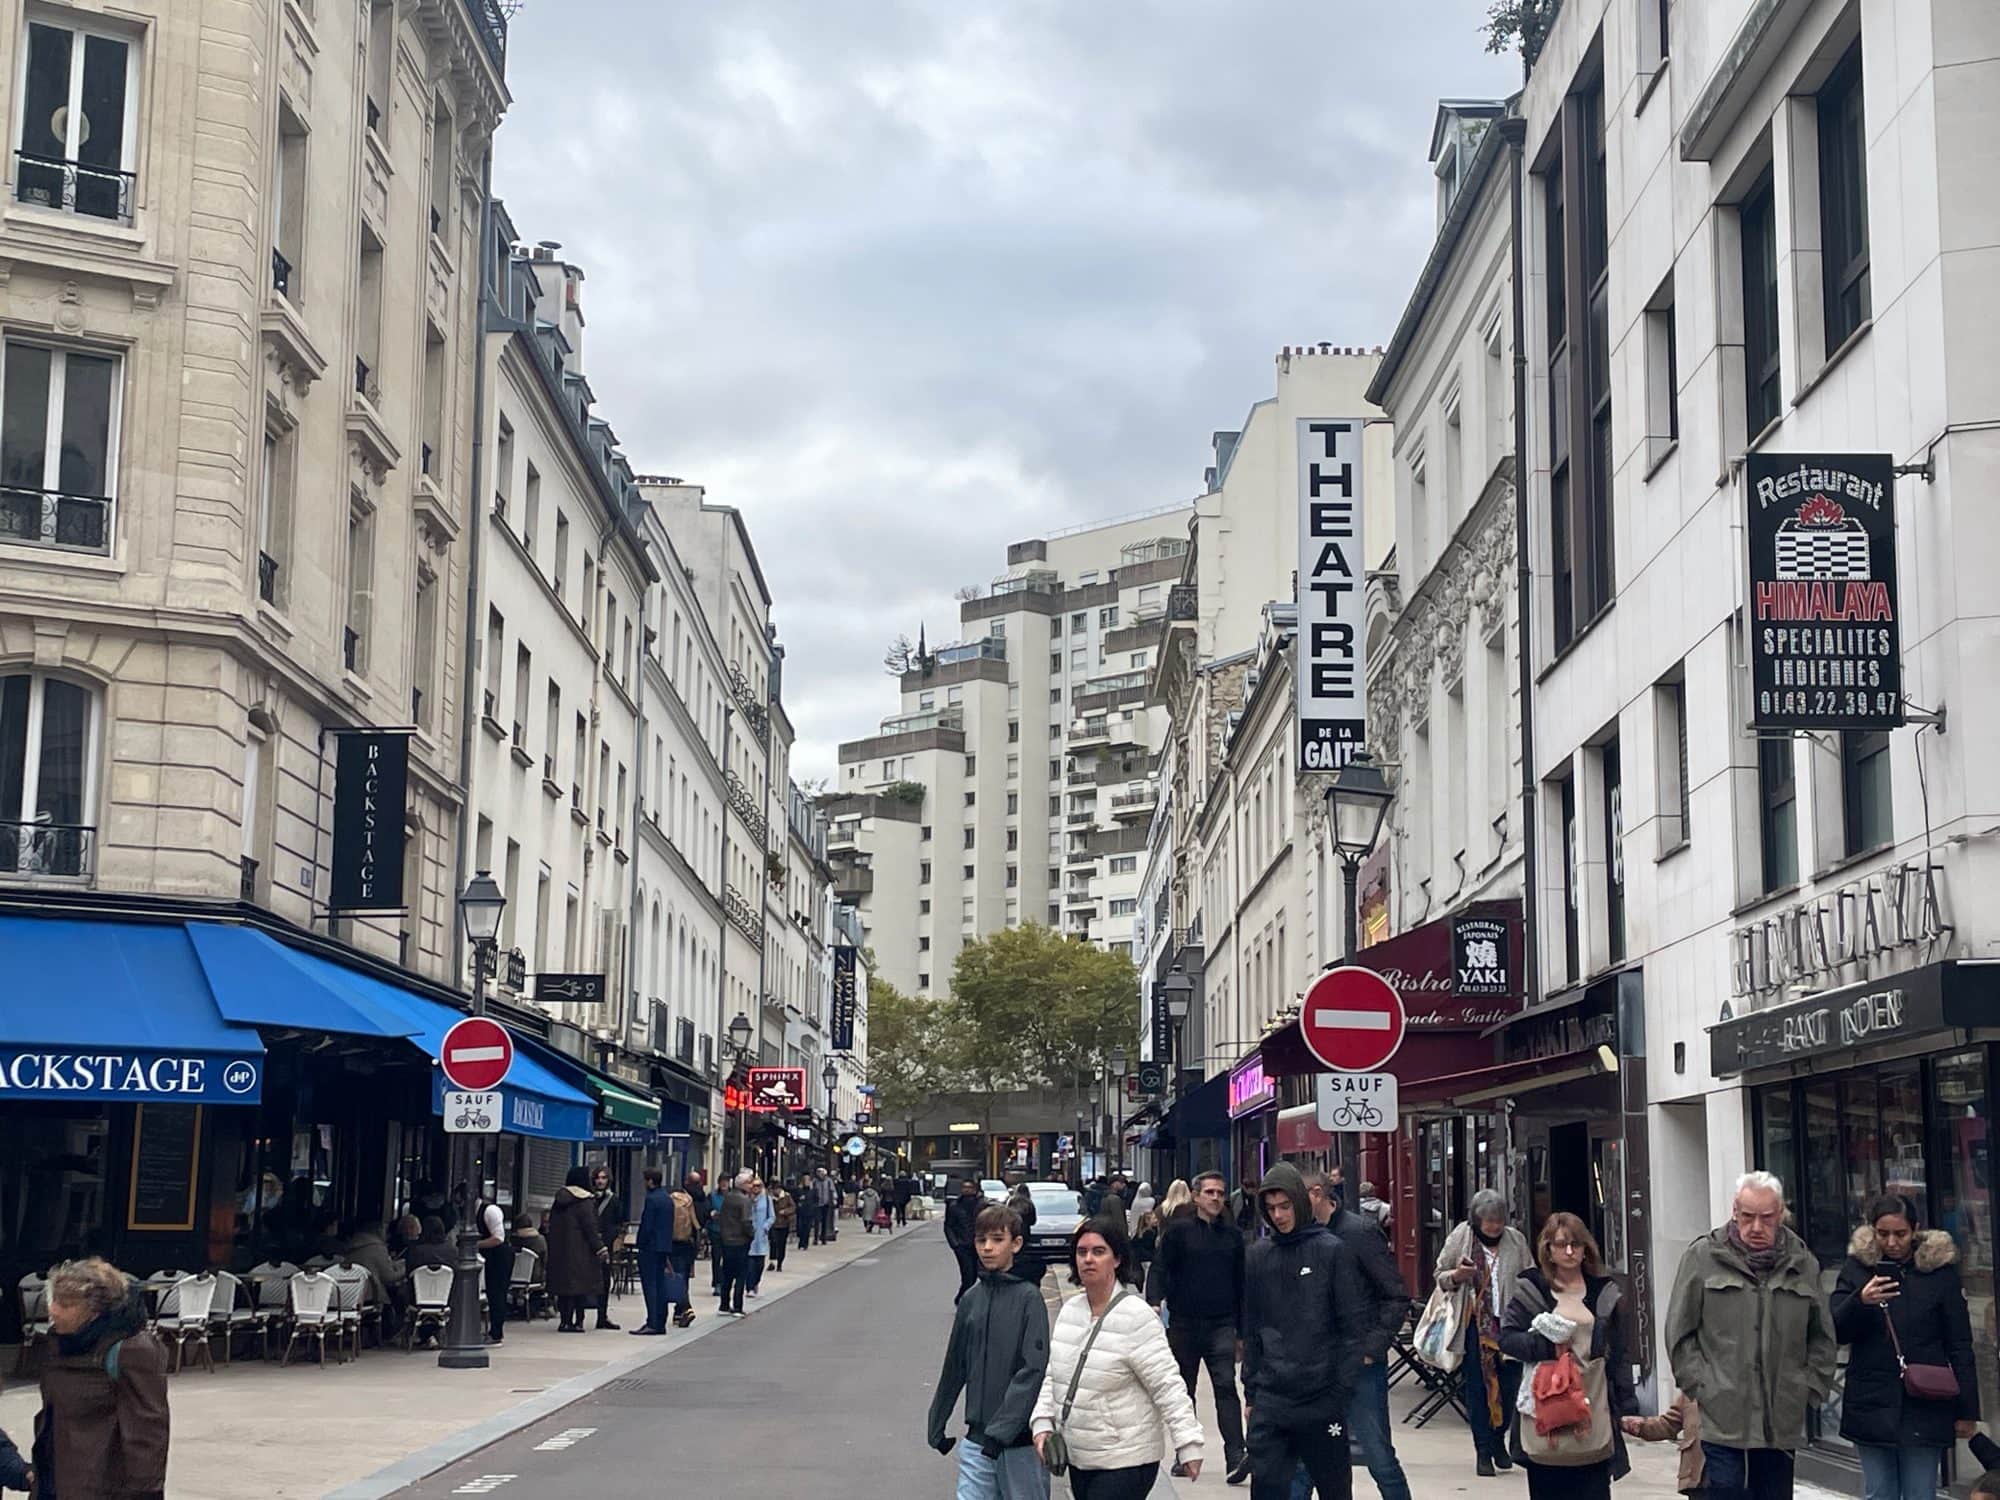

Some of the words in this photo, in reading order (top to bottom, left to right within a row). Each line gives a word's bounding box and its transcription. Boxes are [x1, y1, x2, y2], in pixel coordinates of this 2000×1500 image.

[1756, 463, 1884, 511] Restaurant
[1309, 423, 1354, 699] THEATRE
[1756, 580, 1893, 622] HIMALAYA
[1763, 627, 1890, 656] SPECIALITES
[1774, 659, 1880, 687] INDIENNES
[1318, 728, 1332, 738] DE
[1339, 728, 1352, 738] LA
[360, 745, 379, 899] BACKSTAGE
[1456, 921, 1505, 934] RESTAURANT
[1378, 967, 1452, 992] Bistro
[1458, 969, 1506, 983] YAKI
[844, 971, 854, 1027] HOTEL
[1331, 1077, 1383, 1092] SAUF
[455, 1094, 493, 1105] SAUF
